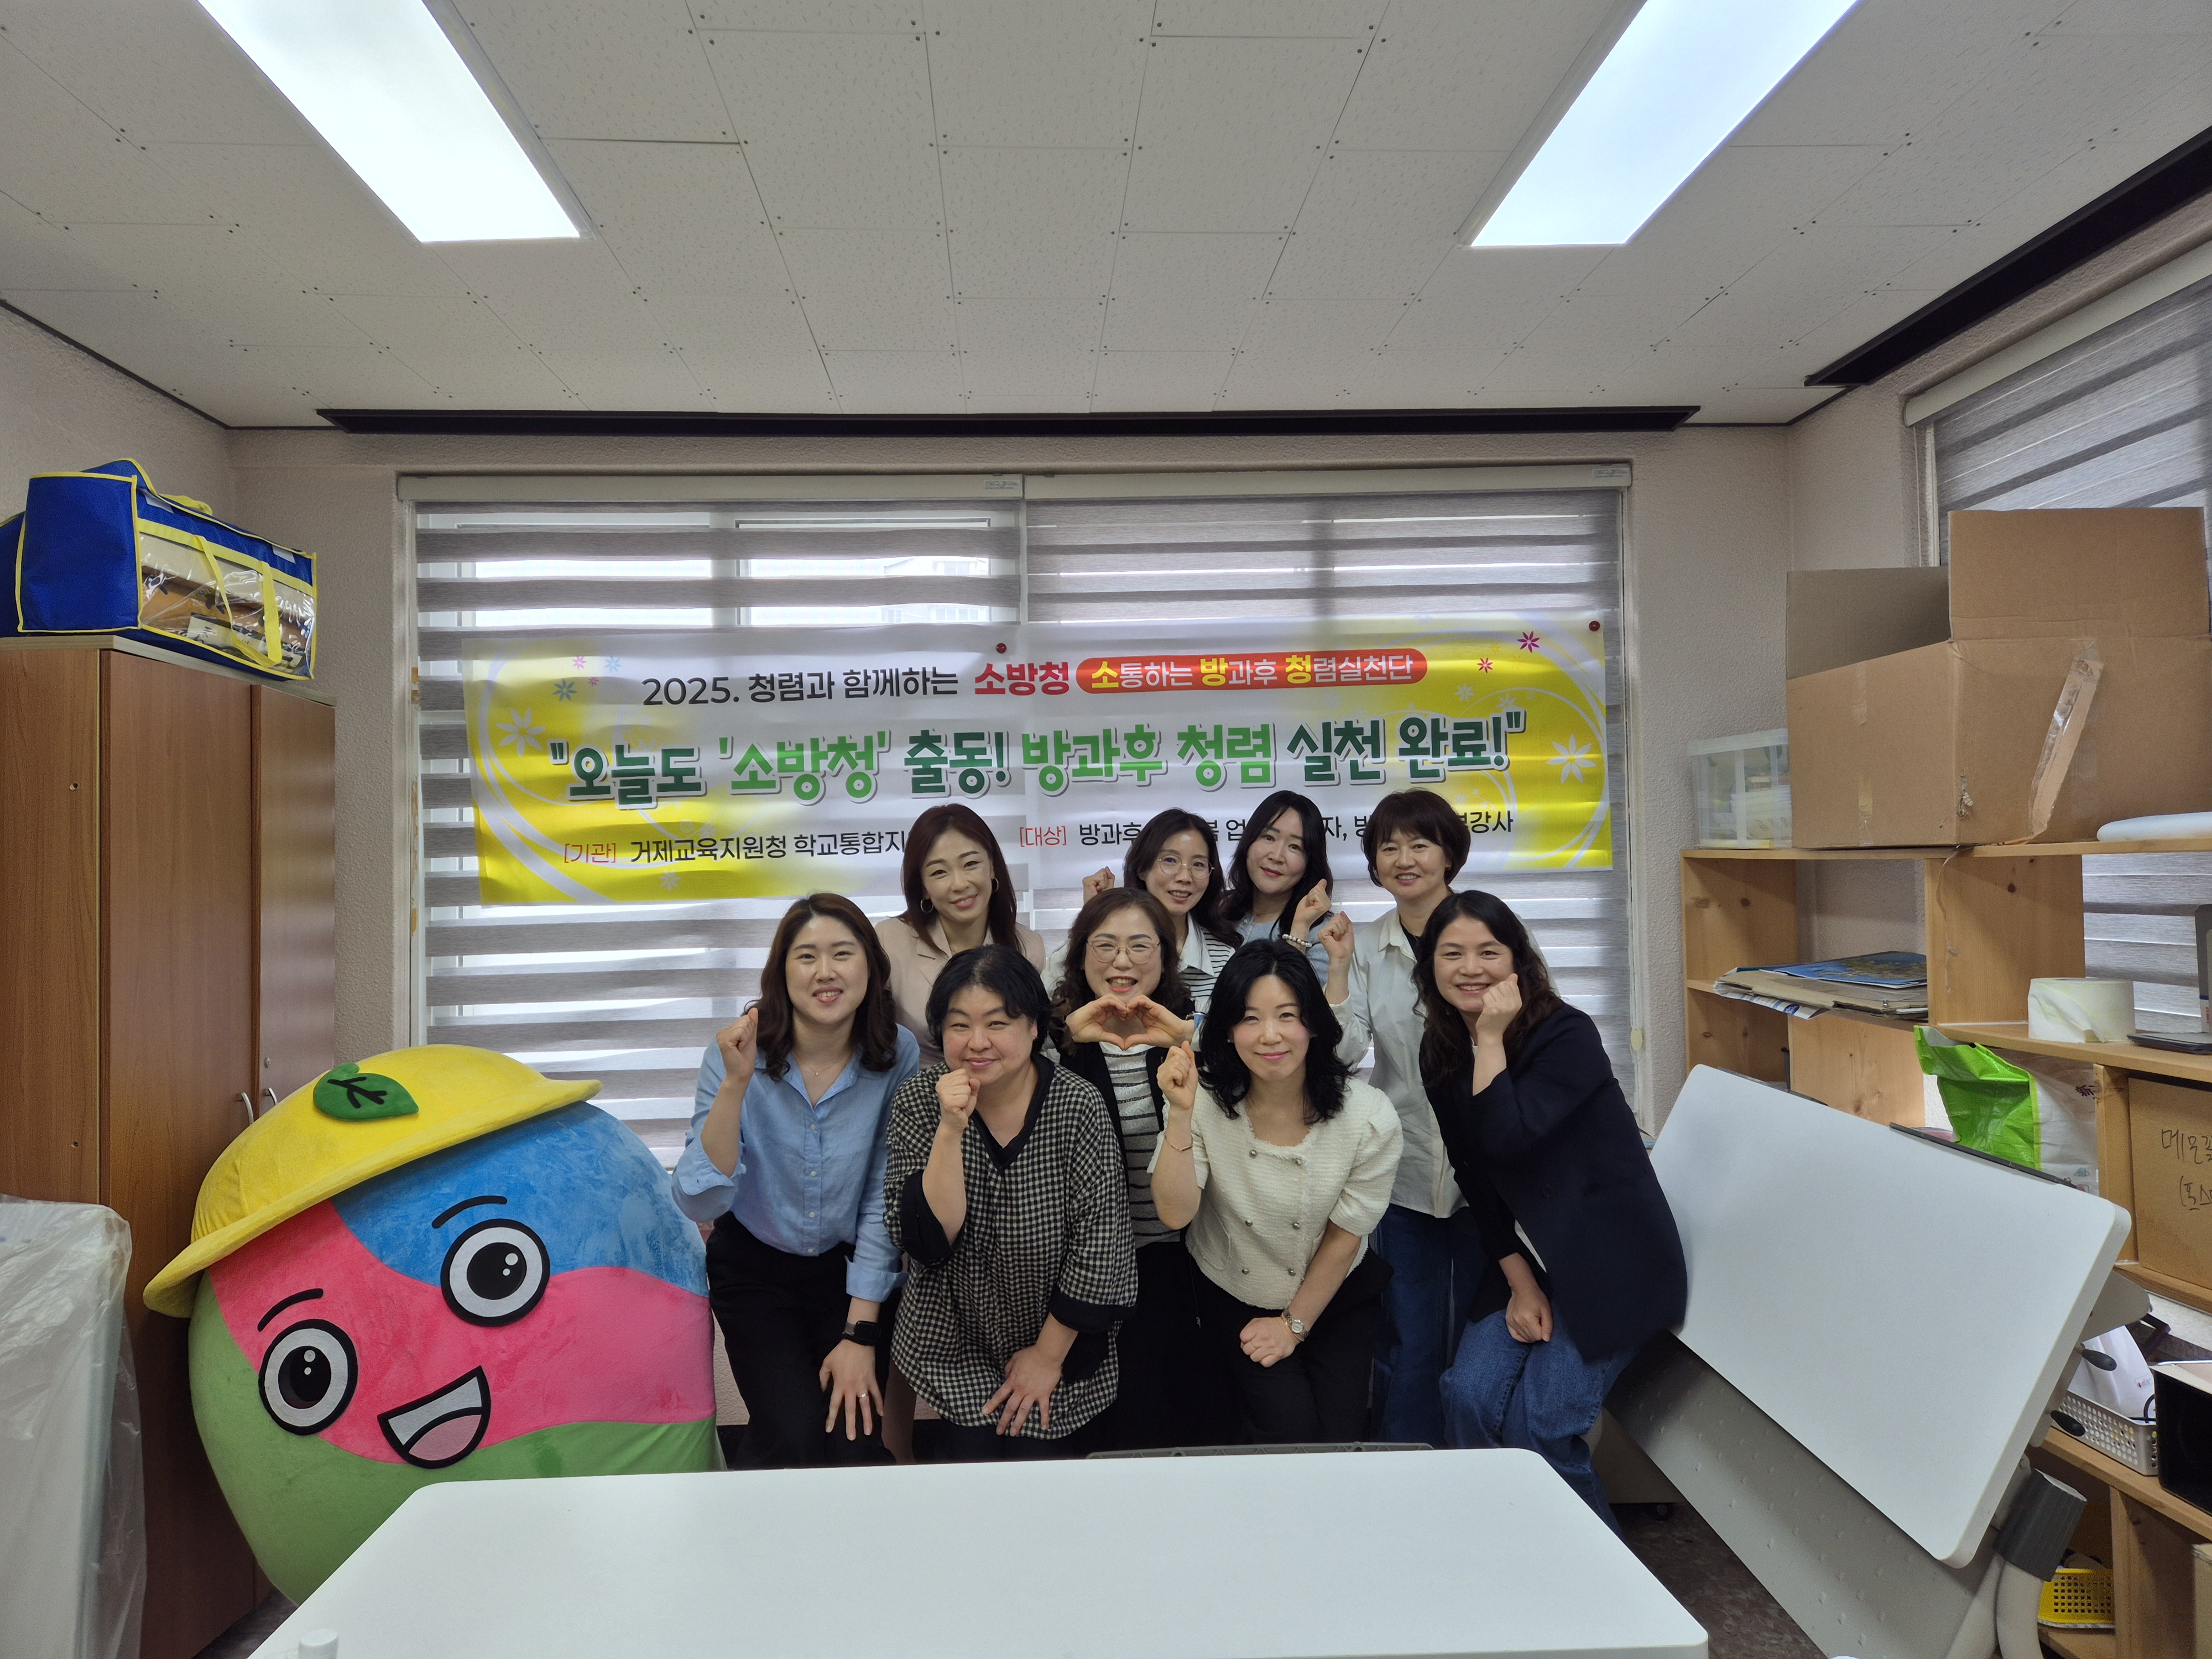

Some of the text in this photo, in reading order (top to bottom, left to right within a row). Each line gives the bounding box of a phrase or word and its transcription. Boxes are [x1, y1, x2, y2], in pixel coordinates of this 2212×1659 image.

[641, 661, 1070, 706] 2025. 청렴과 함께하는 소방청
[1091, 654, 1413, 689] 소통하는 방과후 청렴실천단
[549, 710, 1523, 806] "오늘도 '소방청' 출동! 방과후 청렴 실천 완료!"
[564, 830, 906, 864] [기관] 거제교육지원청 학교통합지
[1019, 825, 1067, 847] [대상]
[1079, 821, 1142, 846] 방과후
[1225, 818, 1246, 842] 업
[1322, 815, 1348, 841] 자,
[1460, 810, 1514, 834] 강사
